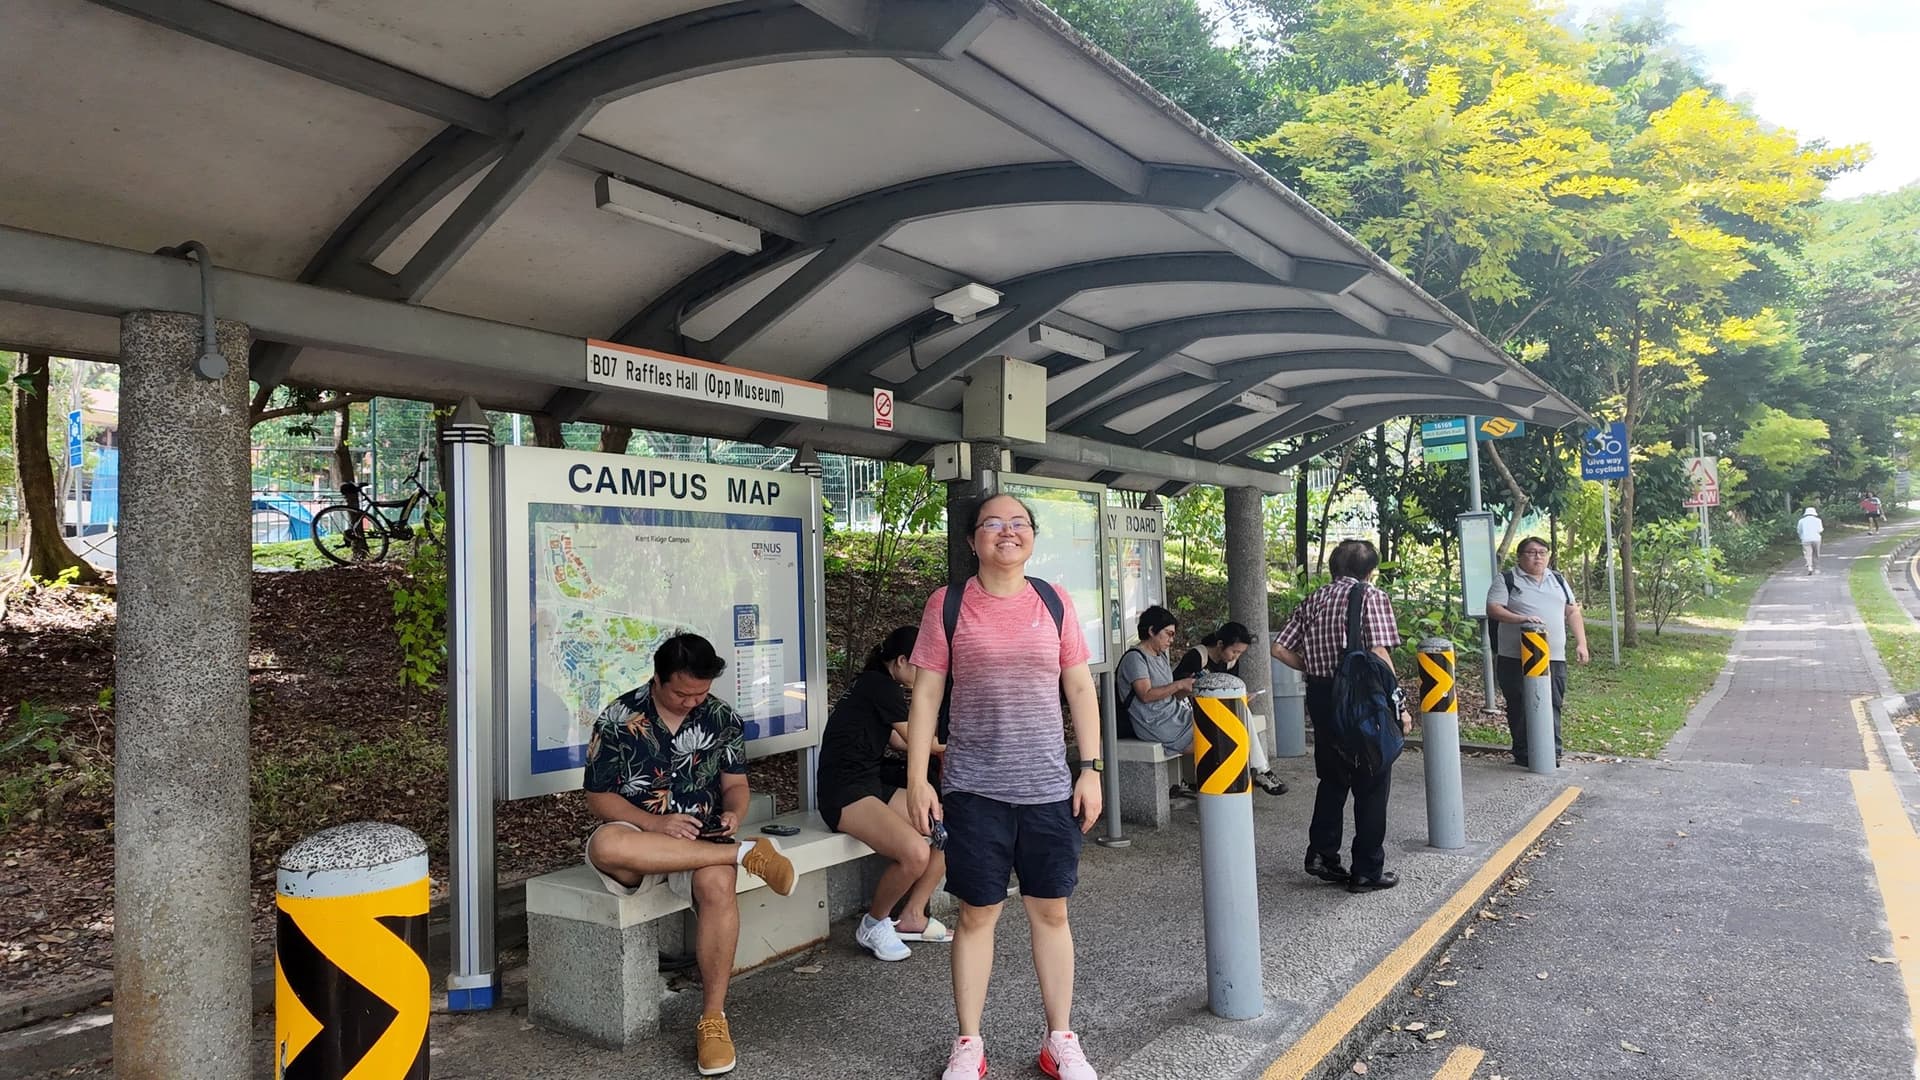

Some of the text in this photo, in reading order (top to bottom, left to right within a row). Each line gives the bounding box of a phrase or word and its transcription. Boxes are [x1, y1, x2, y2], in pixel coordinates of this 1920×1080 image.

[593, 354, 784, 408] B07 Raffles Hall (Opp Museum)
[1587, 457, 1622, 466] Give way
[1595, 465, 1625, 475] cyclists
[568, 463, 780, 505] CAMPUS MAP
[1126, 515, 1157, 533] BOARD
[635, 535, 690, 544] Kent Ridge Campus
[763, 543, 782, 554] NUS
